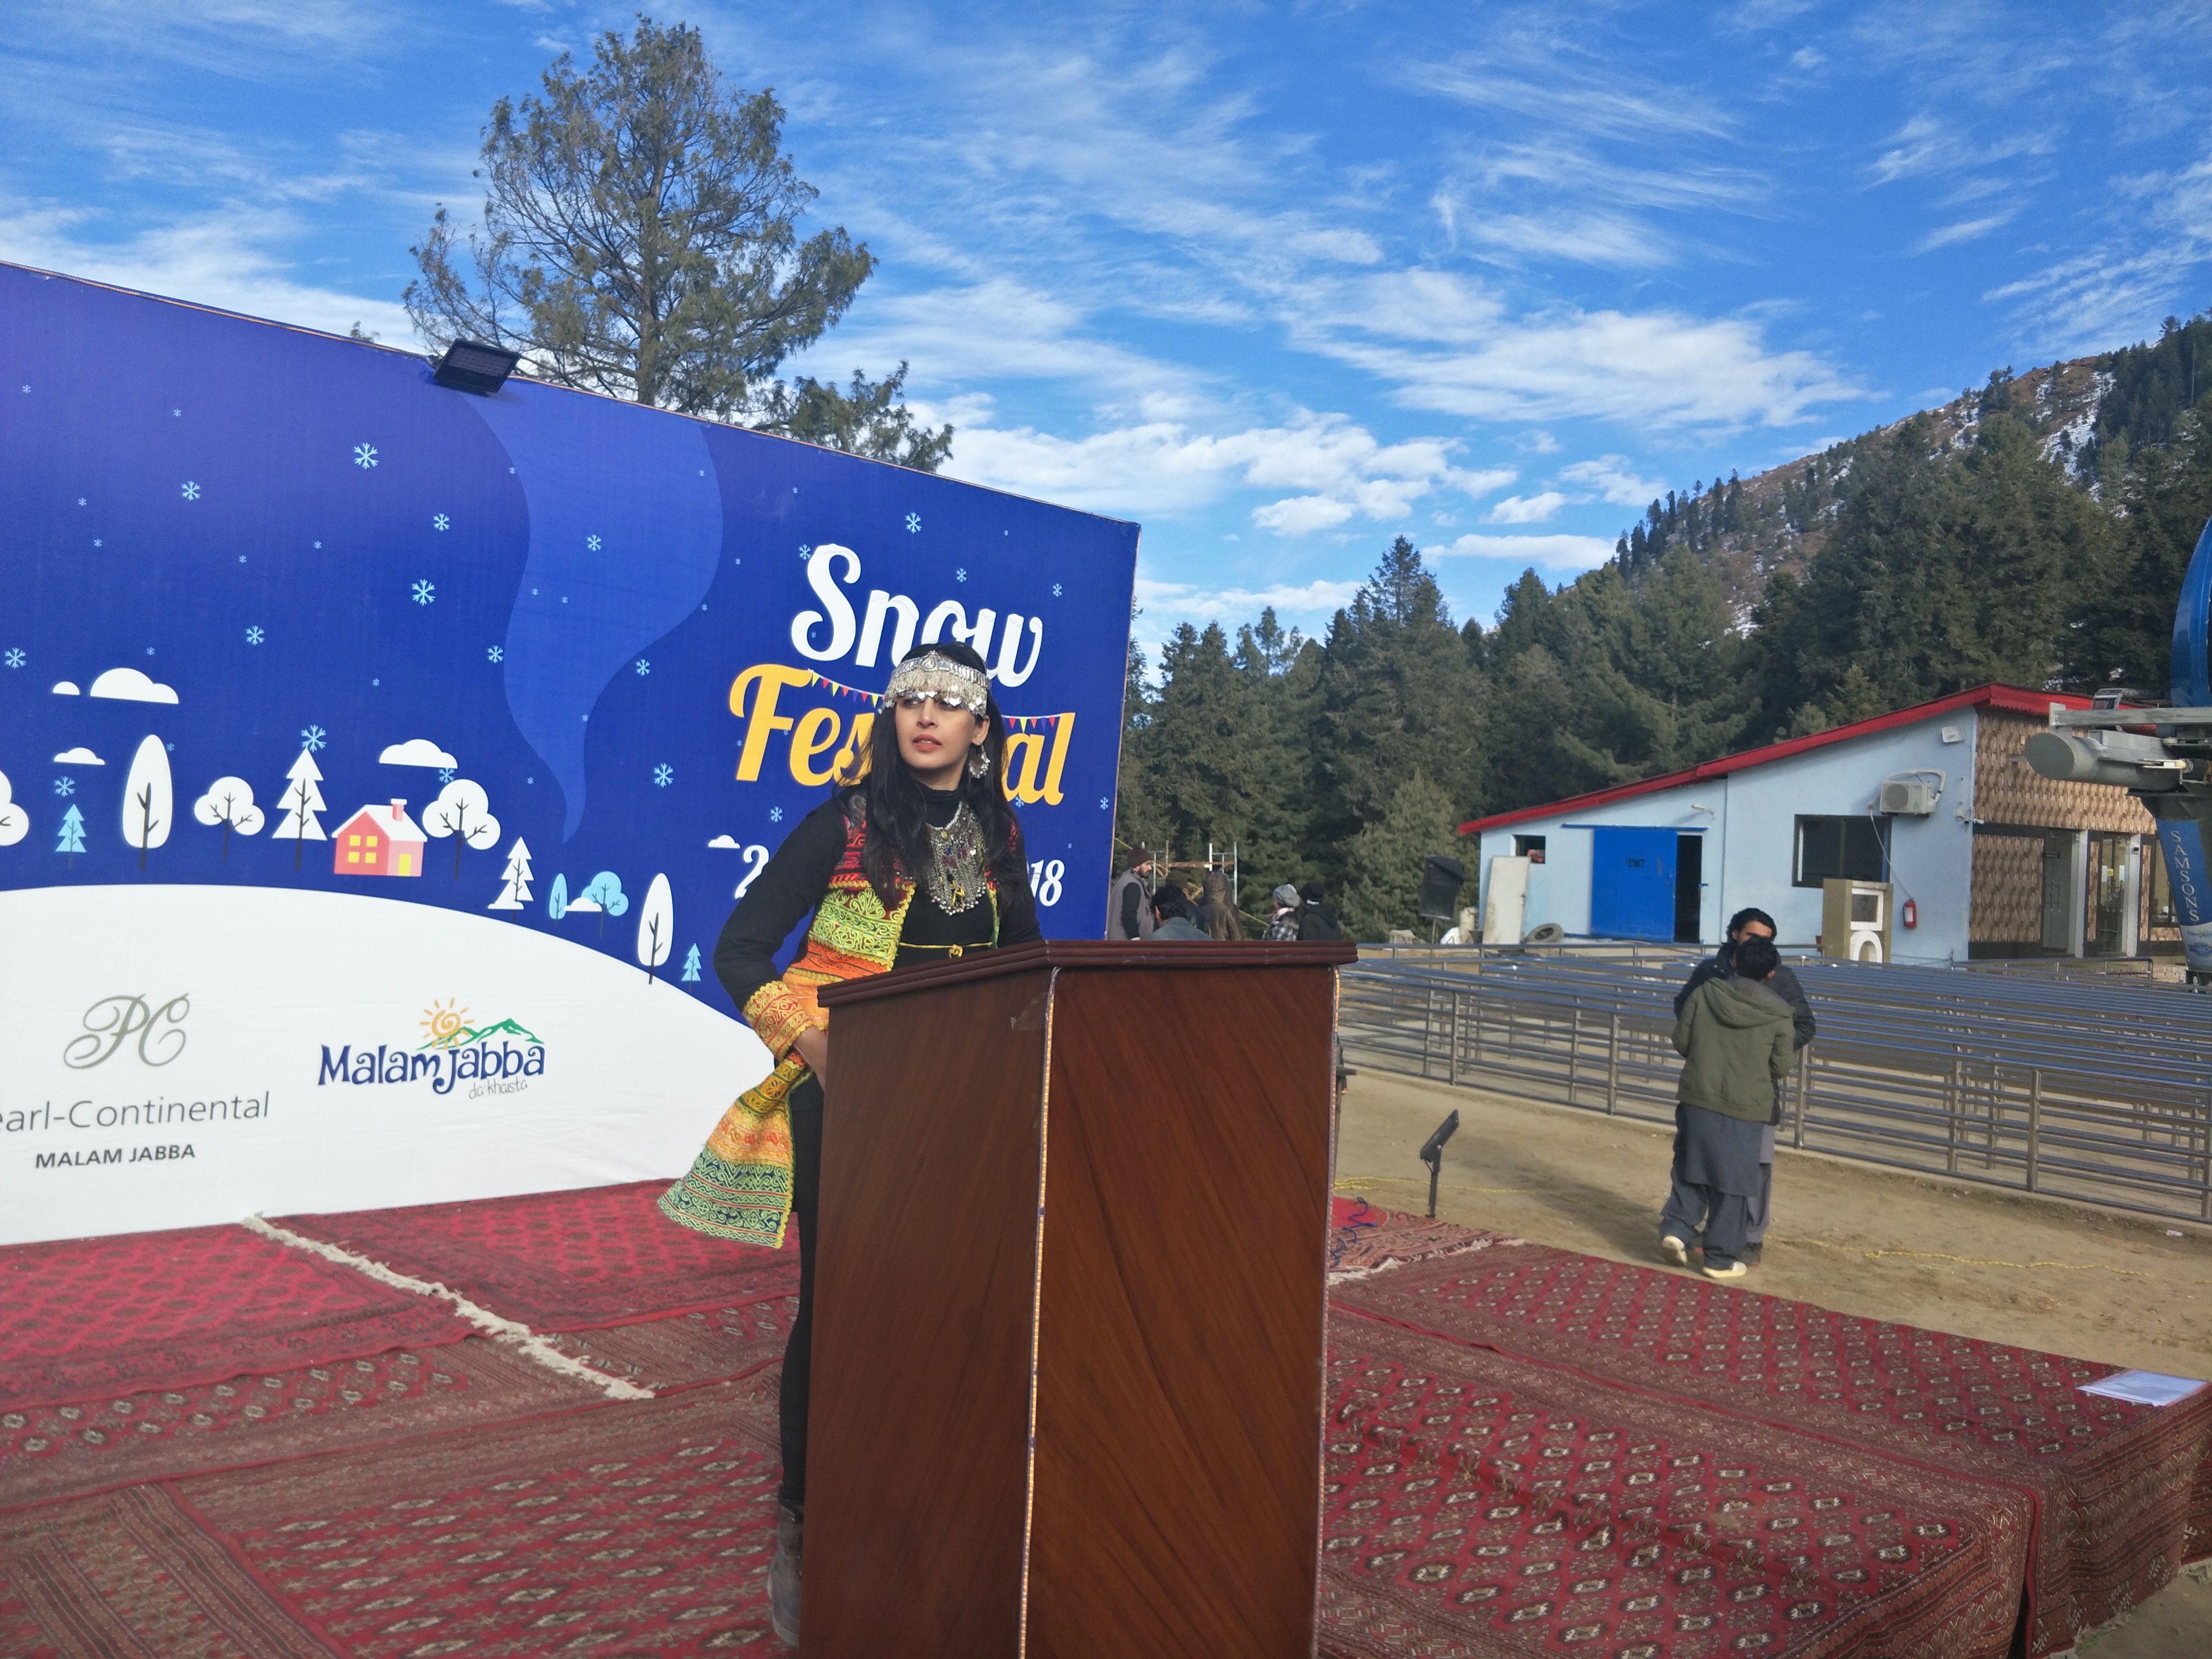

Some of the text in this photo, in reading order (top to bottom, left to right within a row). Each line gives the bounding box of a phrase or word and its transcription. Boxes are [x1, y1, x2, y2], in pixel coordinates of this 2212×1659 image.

[791, 543, 1043, 687] Snow
[730, 663, 1076, 805] Fesal
[1026, 859, 1065, 906] 18
[2171, 830, 2200, 922] SAMSONS
[0, 1091, 269, 1132] arl-Continental
[36, 1143, 195, 1168] MALAM JABBA
